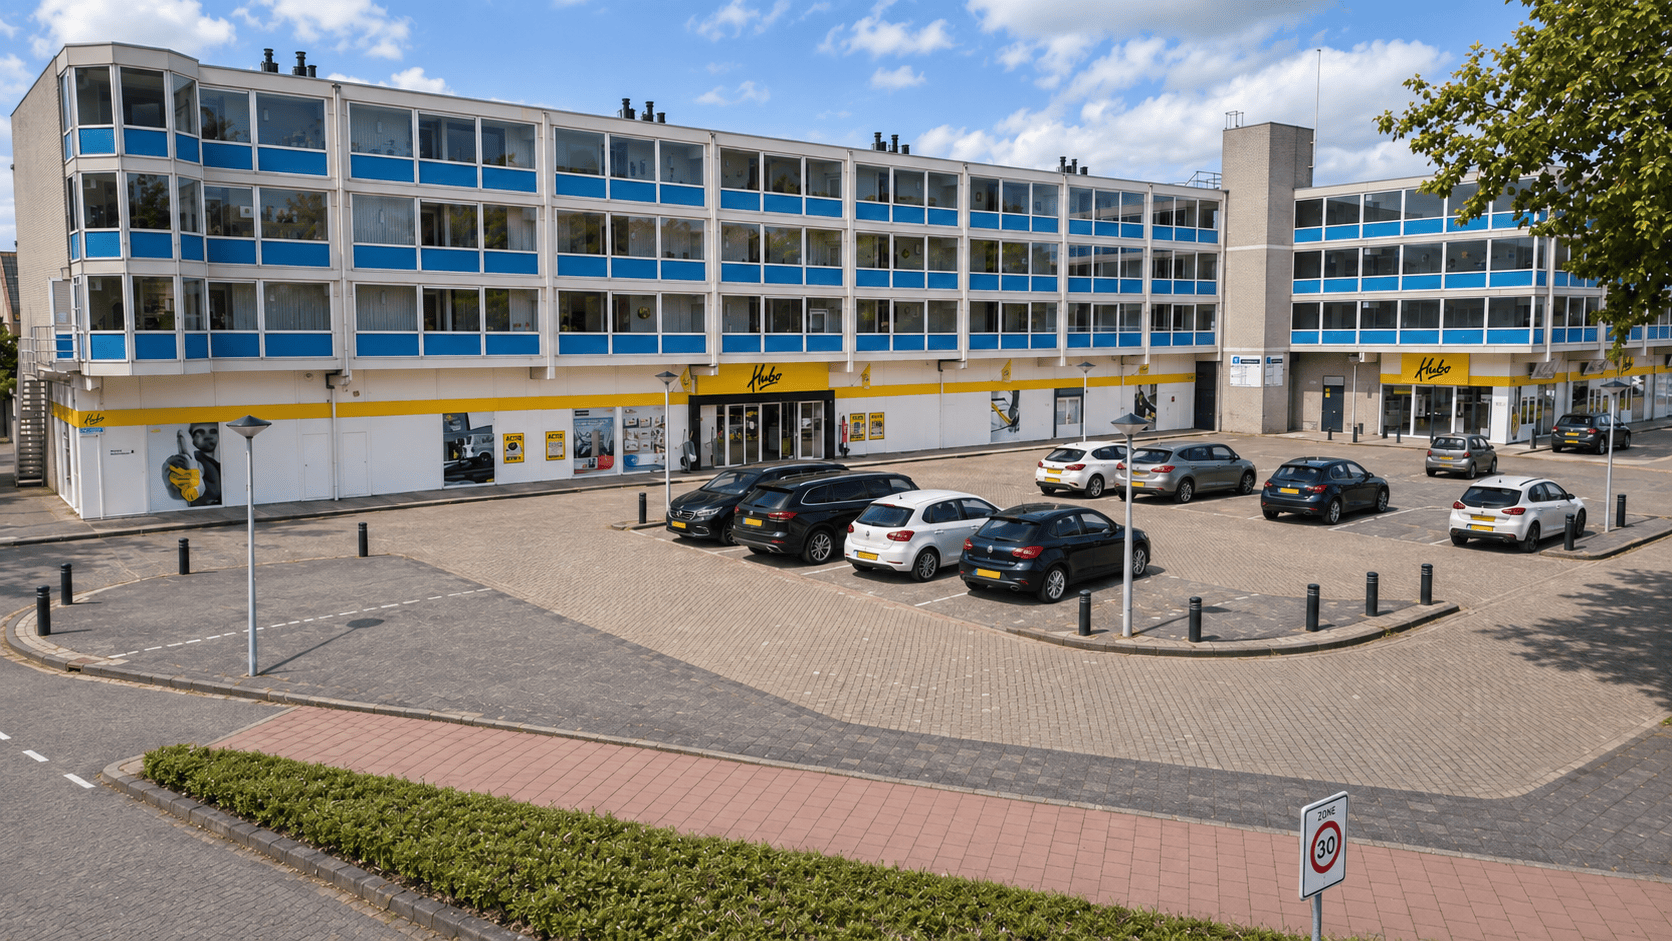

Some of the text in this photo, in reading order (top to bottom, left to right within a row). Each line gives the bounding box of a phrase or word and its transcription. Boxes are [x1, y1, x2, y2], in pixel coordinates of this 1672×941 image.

[747, 363, 783, 393] Hubo
[1414, 357, 1451, 382] Hubo
[1317, 805, 1336, 821] ZONE
[1317, 835, 1335, 859] 30
